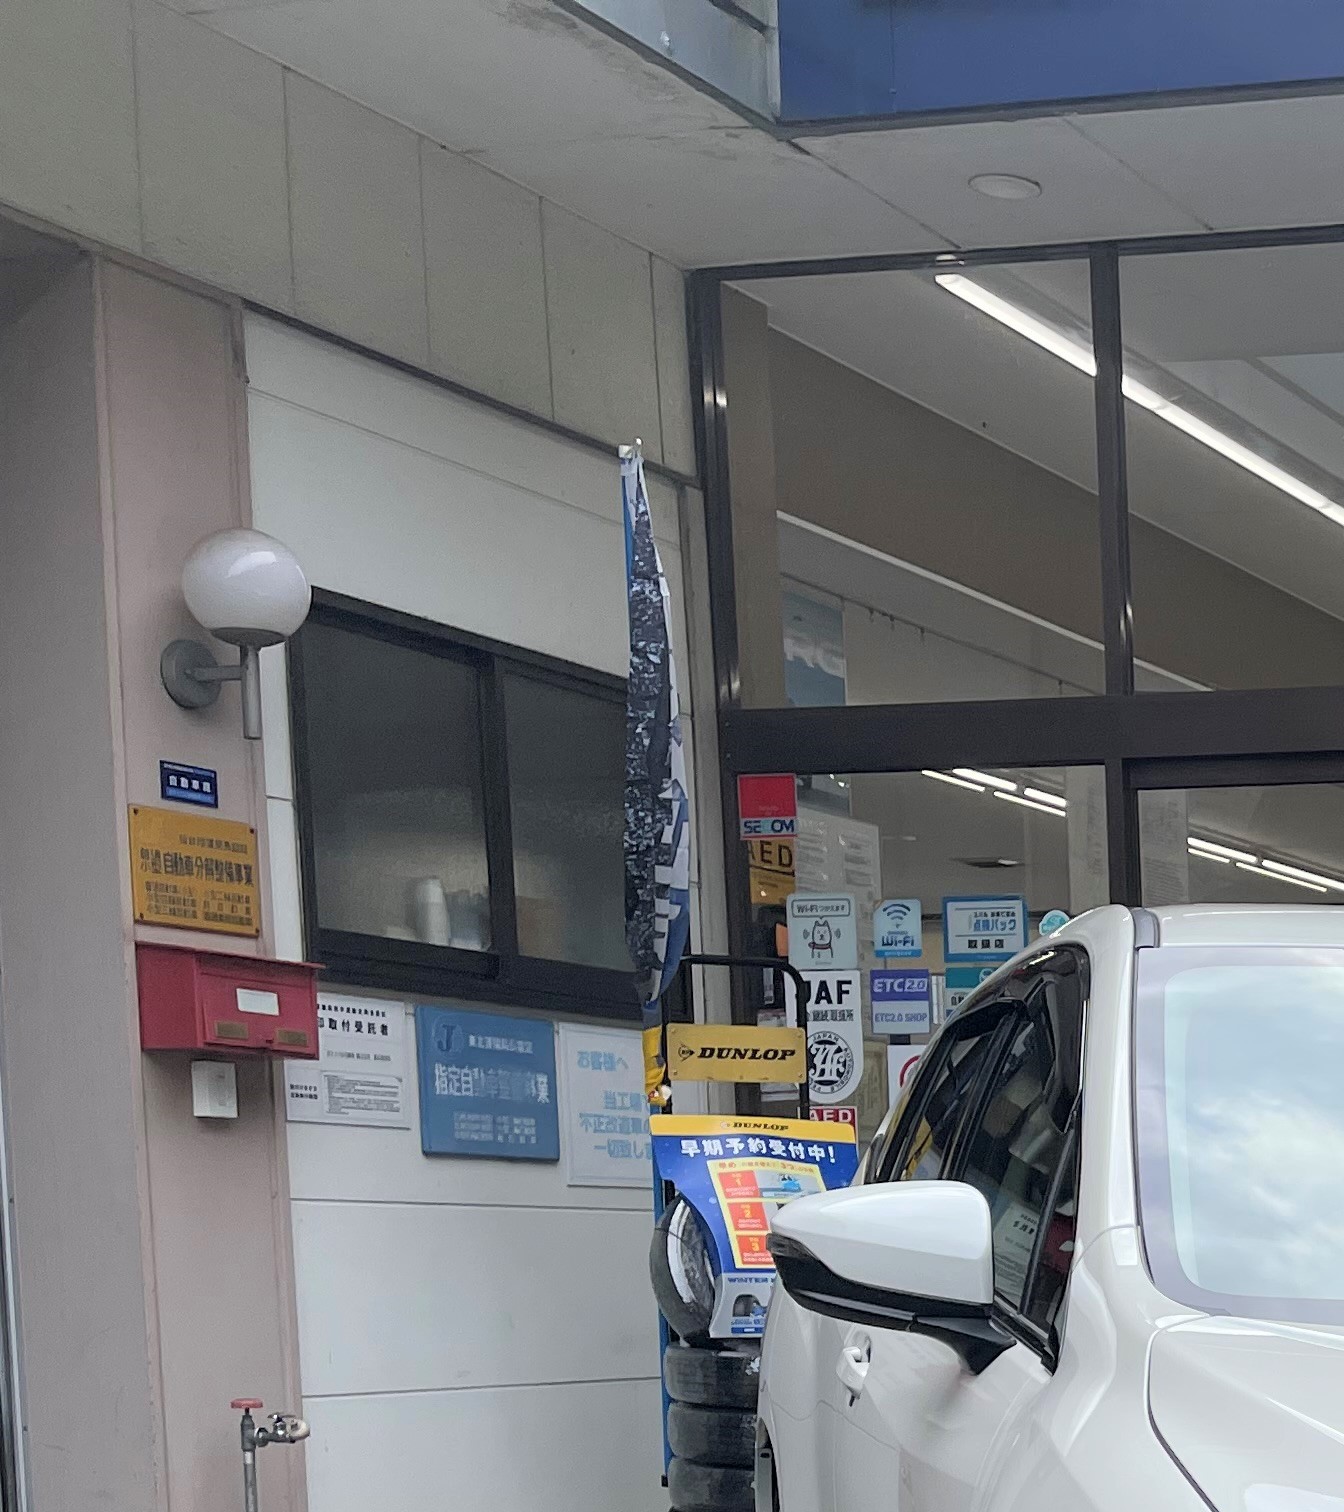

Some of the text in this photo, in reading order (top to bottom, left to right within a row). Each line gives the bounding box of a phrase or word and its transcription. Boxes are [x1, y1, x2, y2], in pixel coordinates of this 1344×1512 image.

[881, 935, 915, 947] Wi-Fi
[967, 938, 1005, 949] 取扱店
[872, 977, 928, 993] ETC2.0
[874, 1013, 928, 1023] ETC2.0 SHOP
[697, 1046, 796, 1061] DUNLOP
[733, 1121, 790, 1132] DUNLOP
